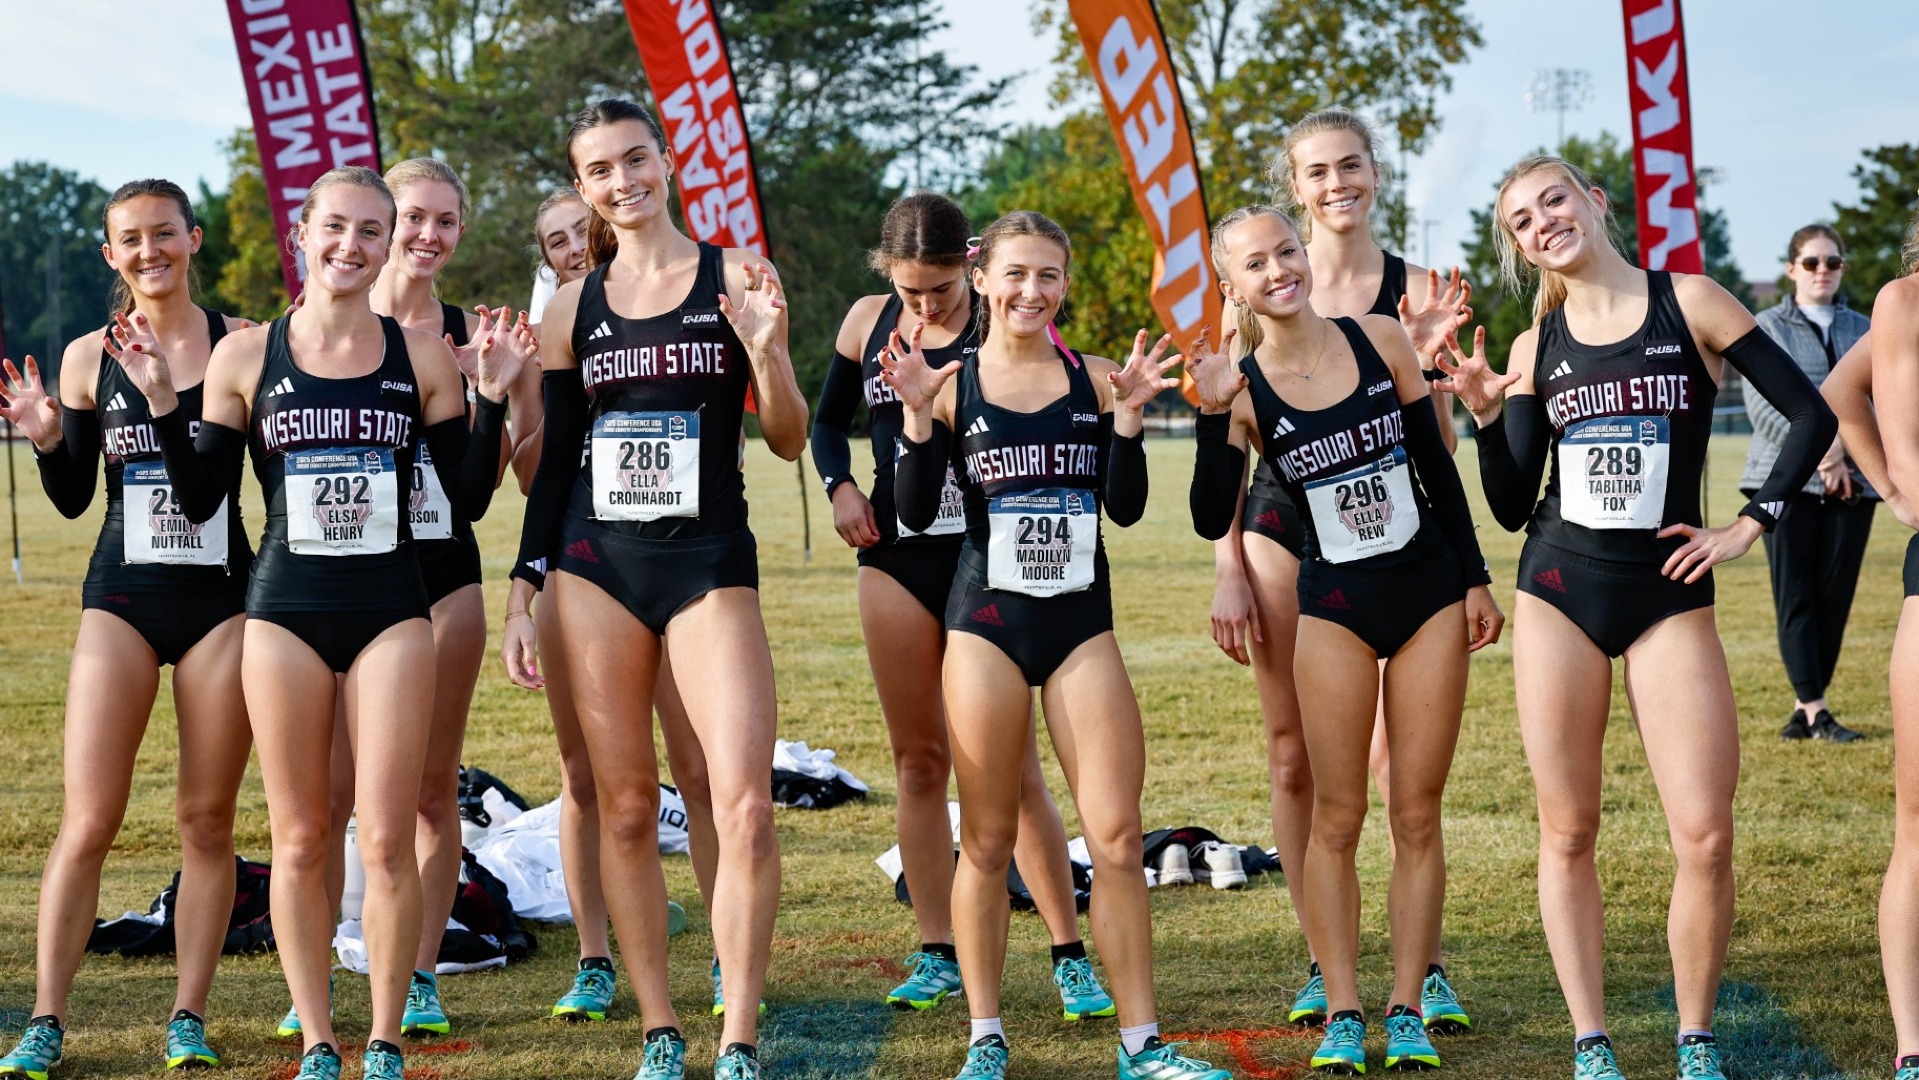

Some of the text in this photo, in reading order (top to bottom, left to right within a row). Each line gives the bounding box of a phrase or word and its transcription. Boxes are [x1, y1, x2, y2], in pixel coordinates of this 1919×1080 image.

[306, 23, 373, 168] TATE
[661, 81, 727, 242] SAM
[1098, 15, 1209, 332] UTEP
[582, 342, 725, 390] MISSOURI STATE
[863, 376, 903, 408] MISS
[1546, 374, 1689, 429] MISSOURI STATE
[261, 408, 413, 450] MISSOURI STATE
[616, 419, 650, 427] CONFERENCE
[1584, 425, 1620, 433] CONFERENCE
[619, 440, 670, 470] 286
[1276, 410, 1404, 483] MISSOURI STATE
[311, 455, 347, 463] CONFERENCE
[964, 443, 1098, 484] MISSOURI STATE
[1587, 446, 1641, 476] 289
[630, 474, 659, 488] ELLA
[1589, 479, 1642, 494] TABITHA
[314, 475, 370, 506] 292
[609, 491, 682, 505] CRONHARDT
[941, 491, 957, 503] EY
[1335, 475, 1387, 511] 296
[937, 505, 962, 519] YAN
[1603, 497, 1627, 511] FOX
[328, 509, 359, 524] ELSA
[410, 510, 439, 524] DSON
[1353, 508, 1383, 526] ELLA
[160, 519, 194, 533] EMILY
[323, 525, 364, 541] HENRY
[1018, 516, 1070, 545] 294
[1358, 524, 1385, 542] REW
[151, 535, 204, 549] NUTTALL
[1016, 549, 1071, 563] MADILYN
[1022, 565, 1065, 580] MOORE
